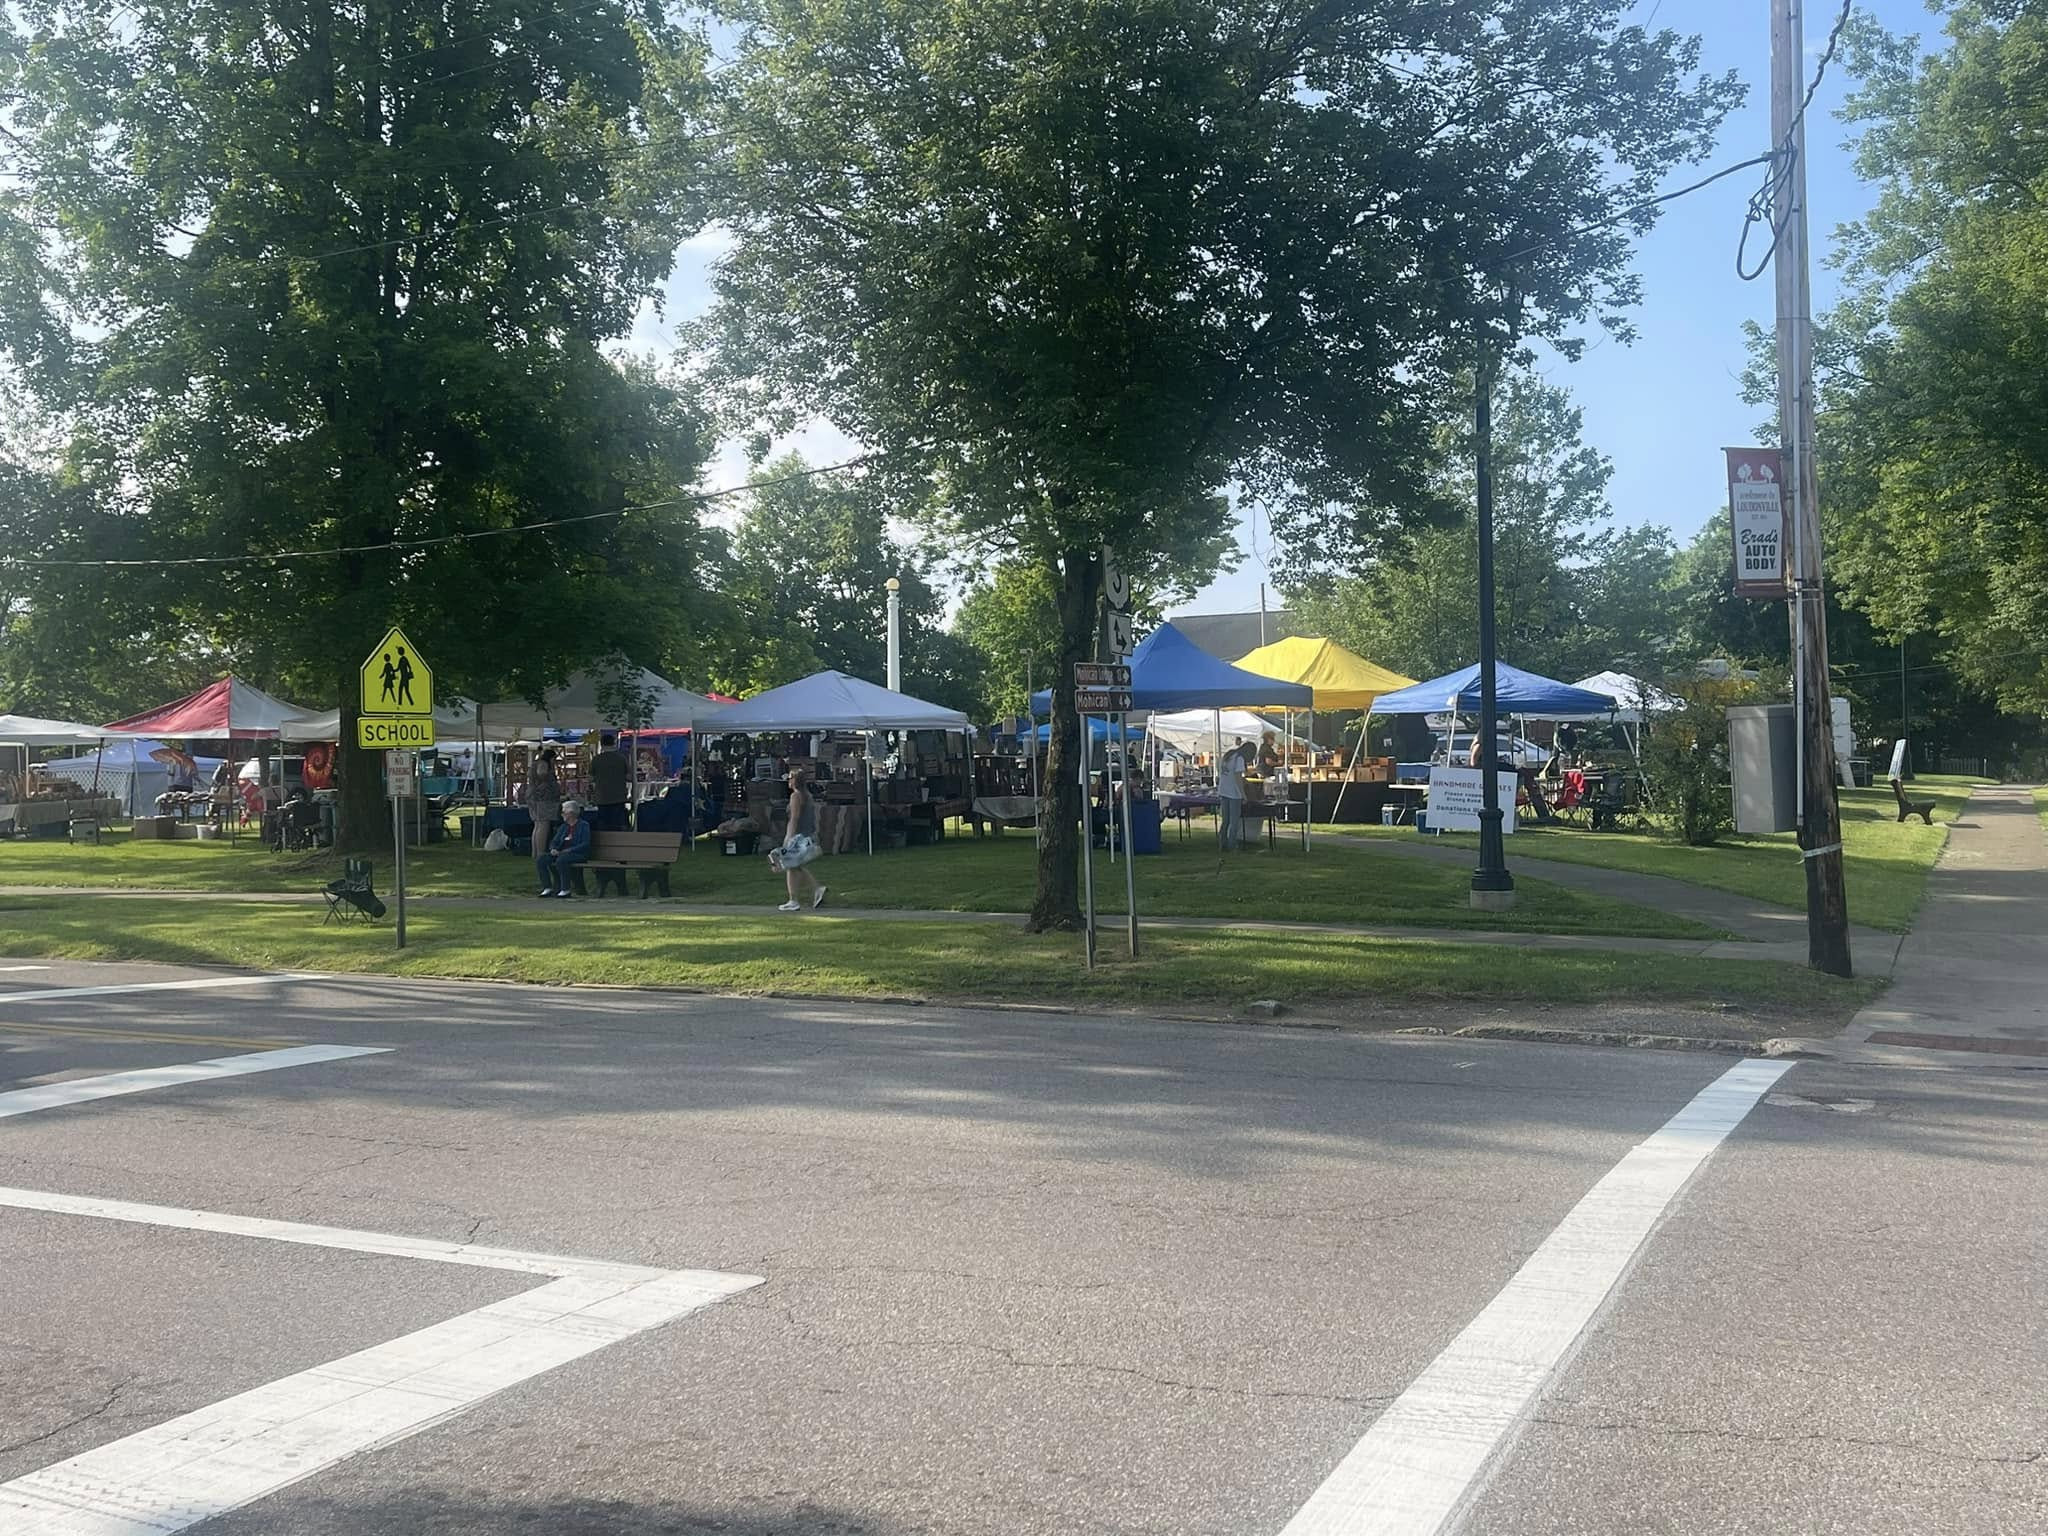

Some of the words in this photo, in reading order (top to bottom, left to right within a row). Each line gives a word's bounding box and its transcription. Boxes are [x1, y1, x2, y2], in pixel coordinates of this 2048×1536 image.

[1736, 501, 1780, 512] LOUDONVILLE
[1740, 528, 1778, 545] Brad's
[1745, 545, 1776, 557] AUTO
[1077, 693, 1109, 708] Mohican
[365, 724, 430, 741] SCHOOL
[1433, 780, 1477, 790] HANDMADE
[1436, 804, 1471, 812] Donations
